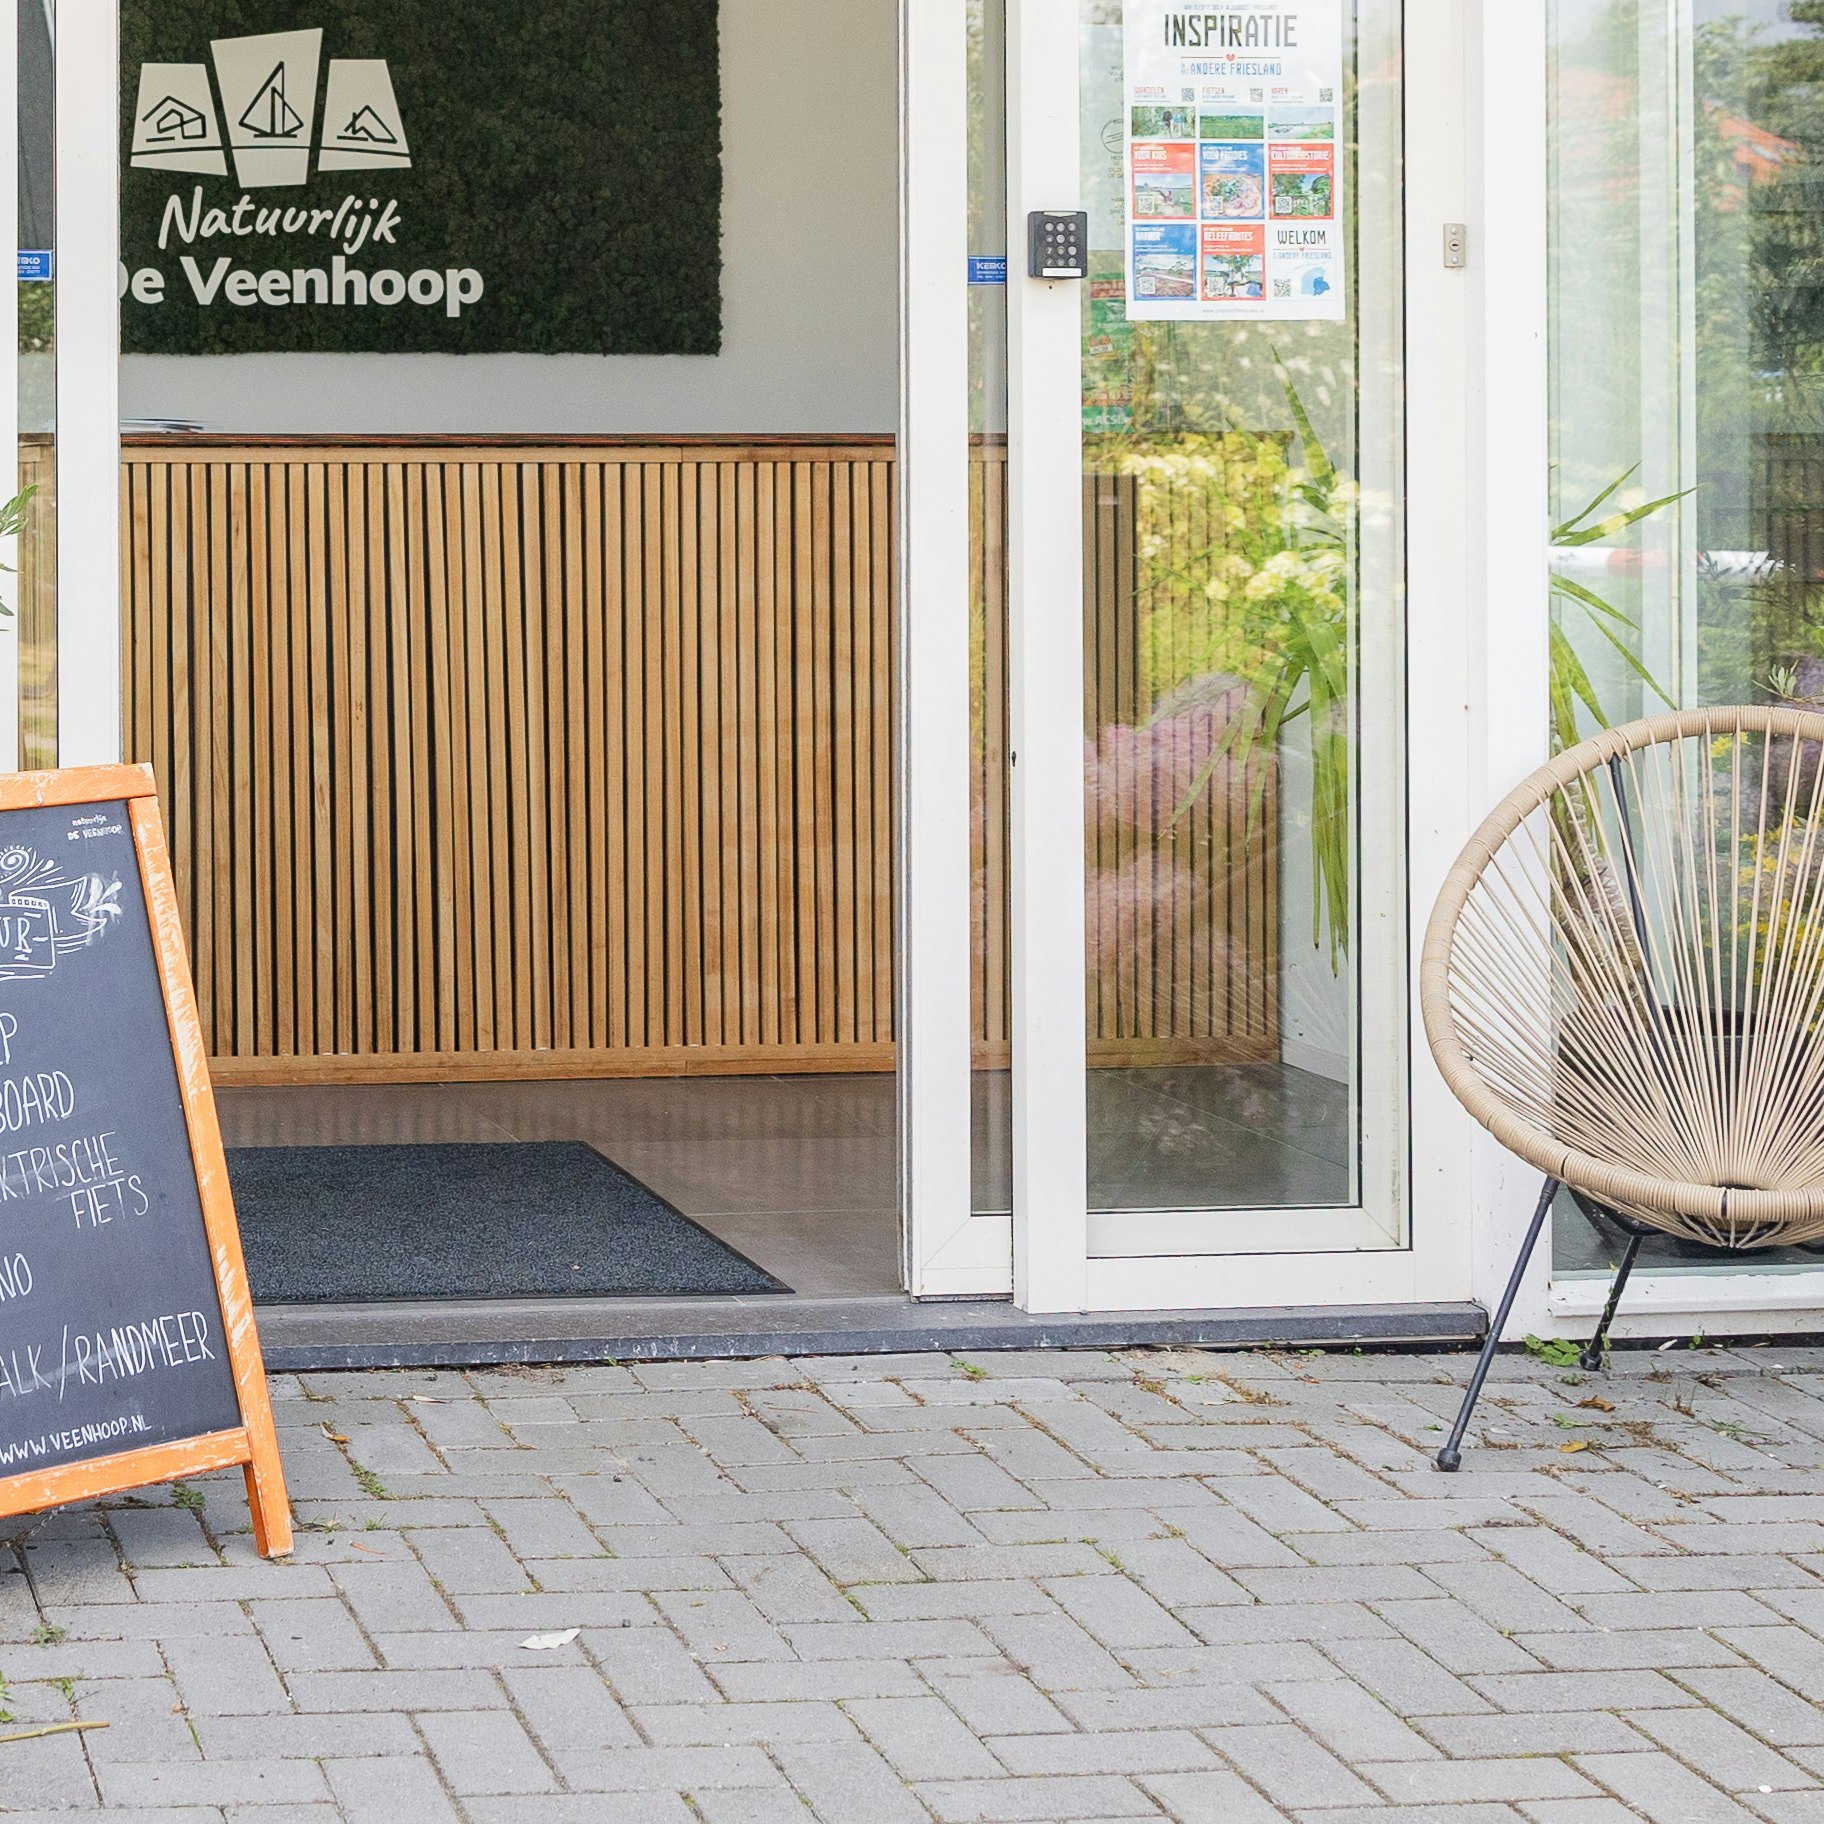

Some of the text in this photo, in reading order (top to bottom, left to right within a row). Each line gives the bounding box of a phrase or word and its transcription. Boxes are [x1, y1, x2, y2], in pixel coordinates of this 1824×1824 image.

[1164, 14, 1298, 47] INSPIRATIE
[1190, 63, 1282, 76] ANDERE FRIESLAND
[156, 185, 402, 255] Natuurlijk
[1277, 230, 1326, 245] WELKOM
[179, 255, 485, 318] Veenhoop
[66, 830, 80, 841] DE
[70, 1173, 149, 1230] FIETS
